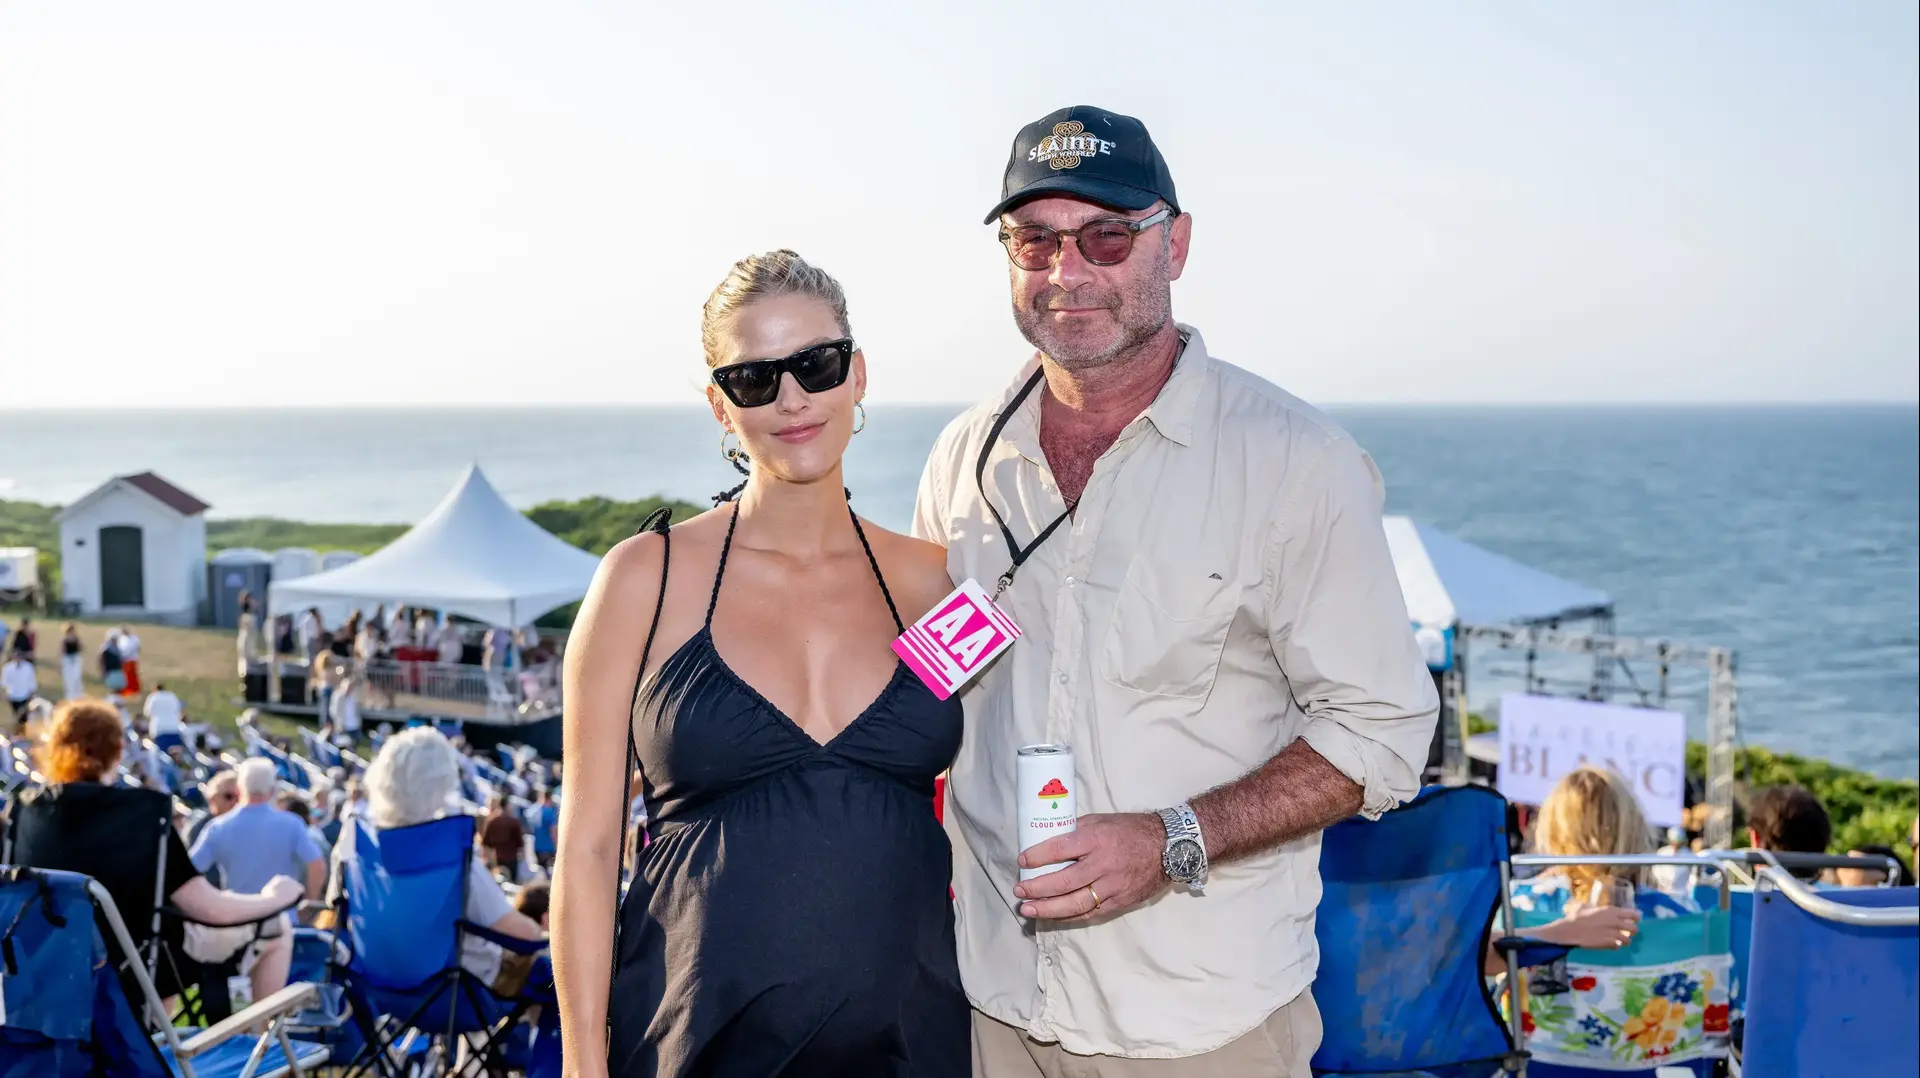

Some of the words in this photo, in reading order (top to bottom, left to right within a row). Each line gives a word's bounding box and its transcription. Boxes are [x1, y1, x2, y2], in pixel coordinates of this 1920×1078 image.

[927, 602, 997, 669] AA
[1030, 821, 1054, 829] CLOUD
[1056, 817, 1076, 828] WATER
[1184, 818, 1200, 842] VIP
